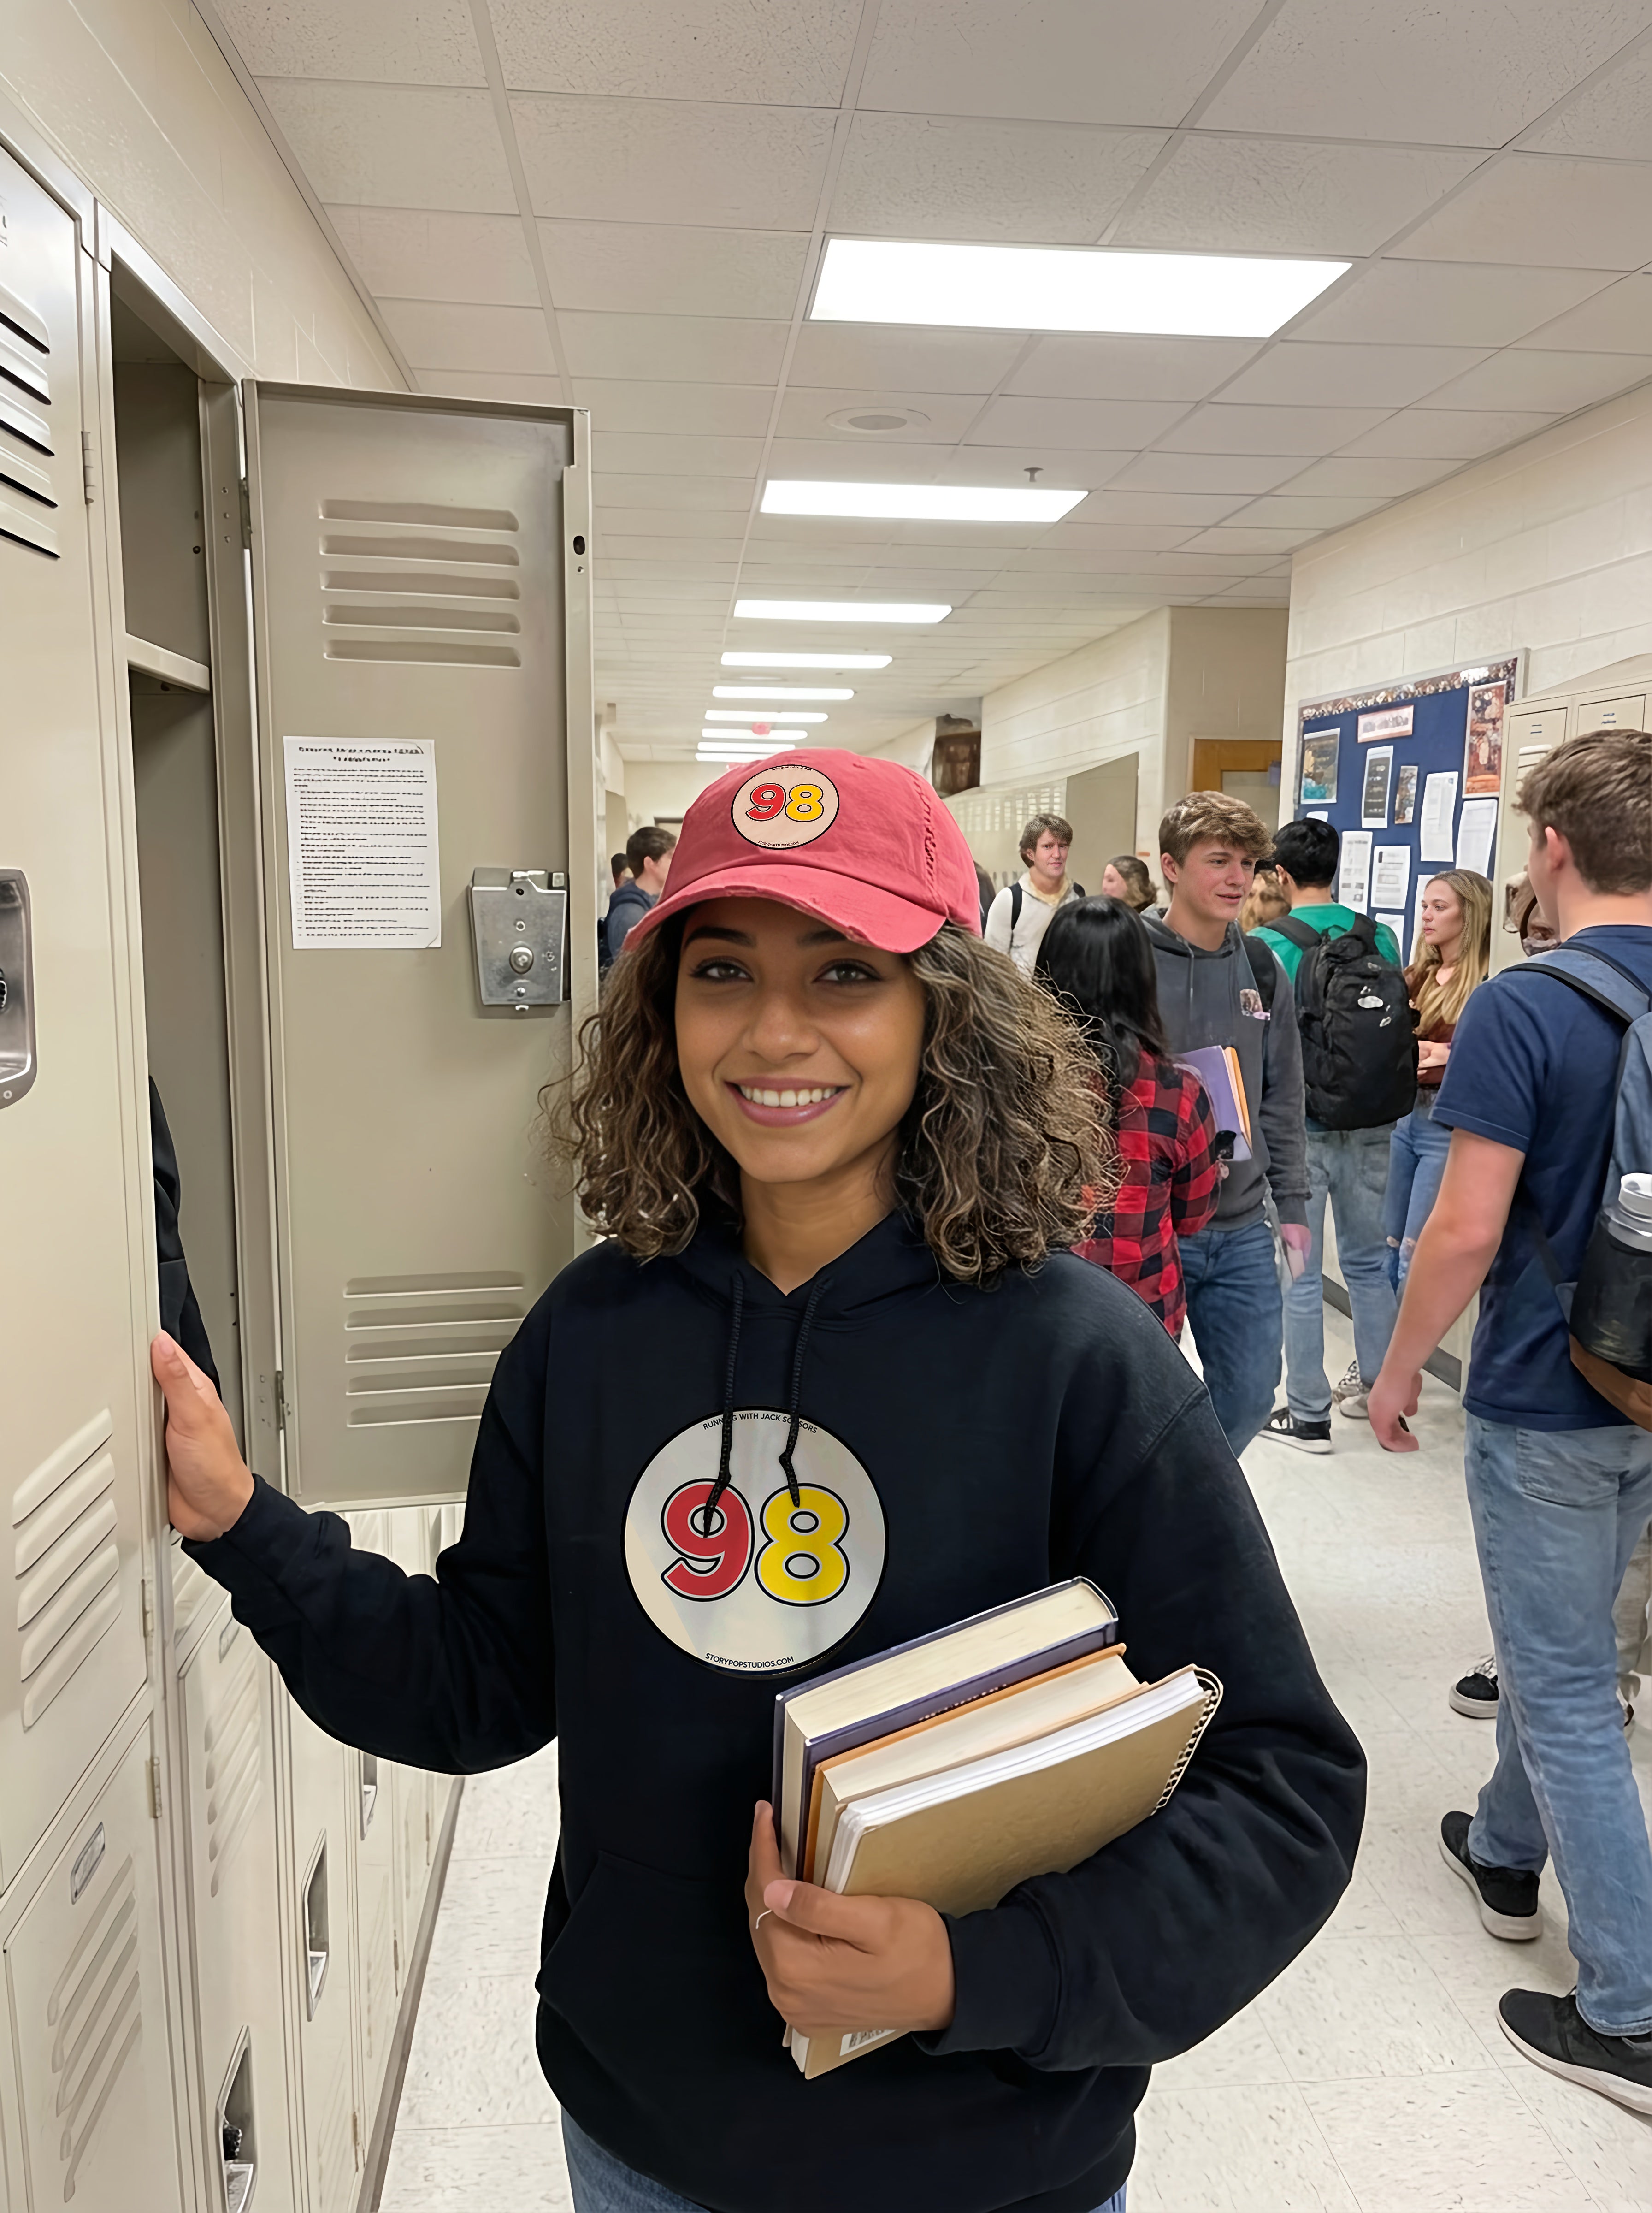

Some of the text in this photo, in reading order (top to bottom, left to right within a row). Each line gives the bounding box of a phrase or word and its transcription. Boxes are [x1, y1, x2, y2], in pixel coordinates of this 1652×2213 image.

[745, 783, 824, 822] 98
[703, 1415, 737, 1430] RUNNG
[782, 1416, 817, 1433] SCSORS
[661, 1478, 850, 1607] 98
[705, 1653, 794, 1668] STORYPOPSTUDIOS.COM
